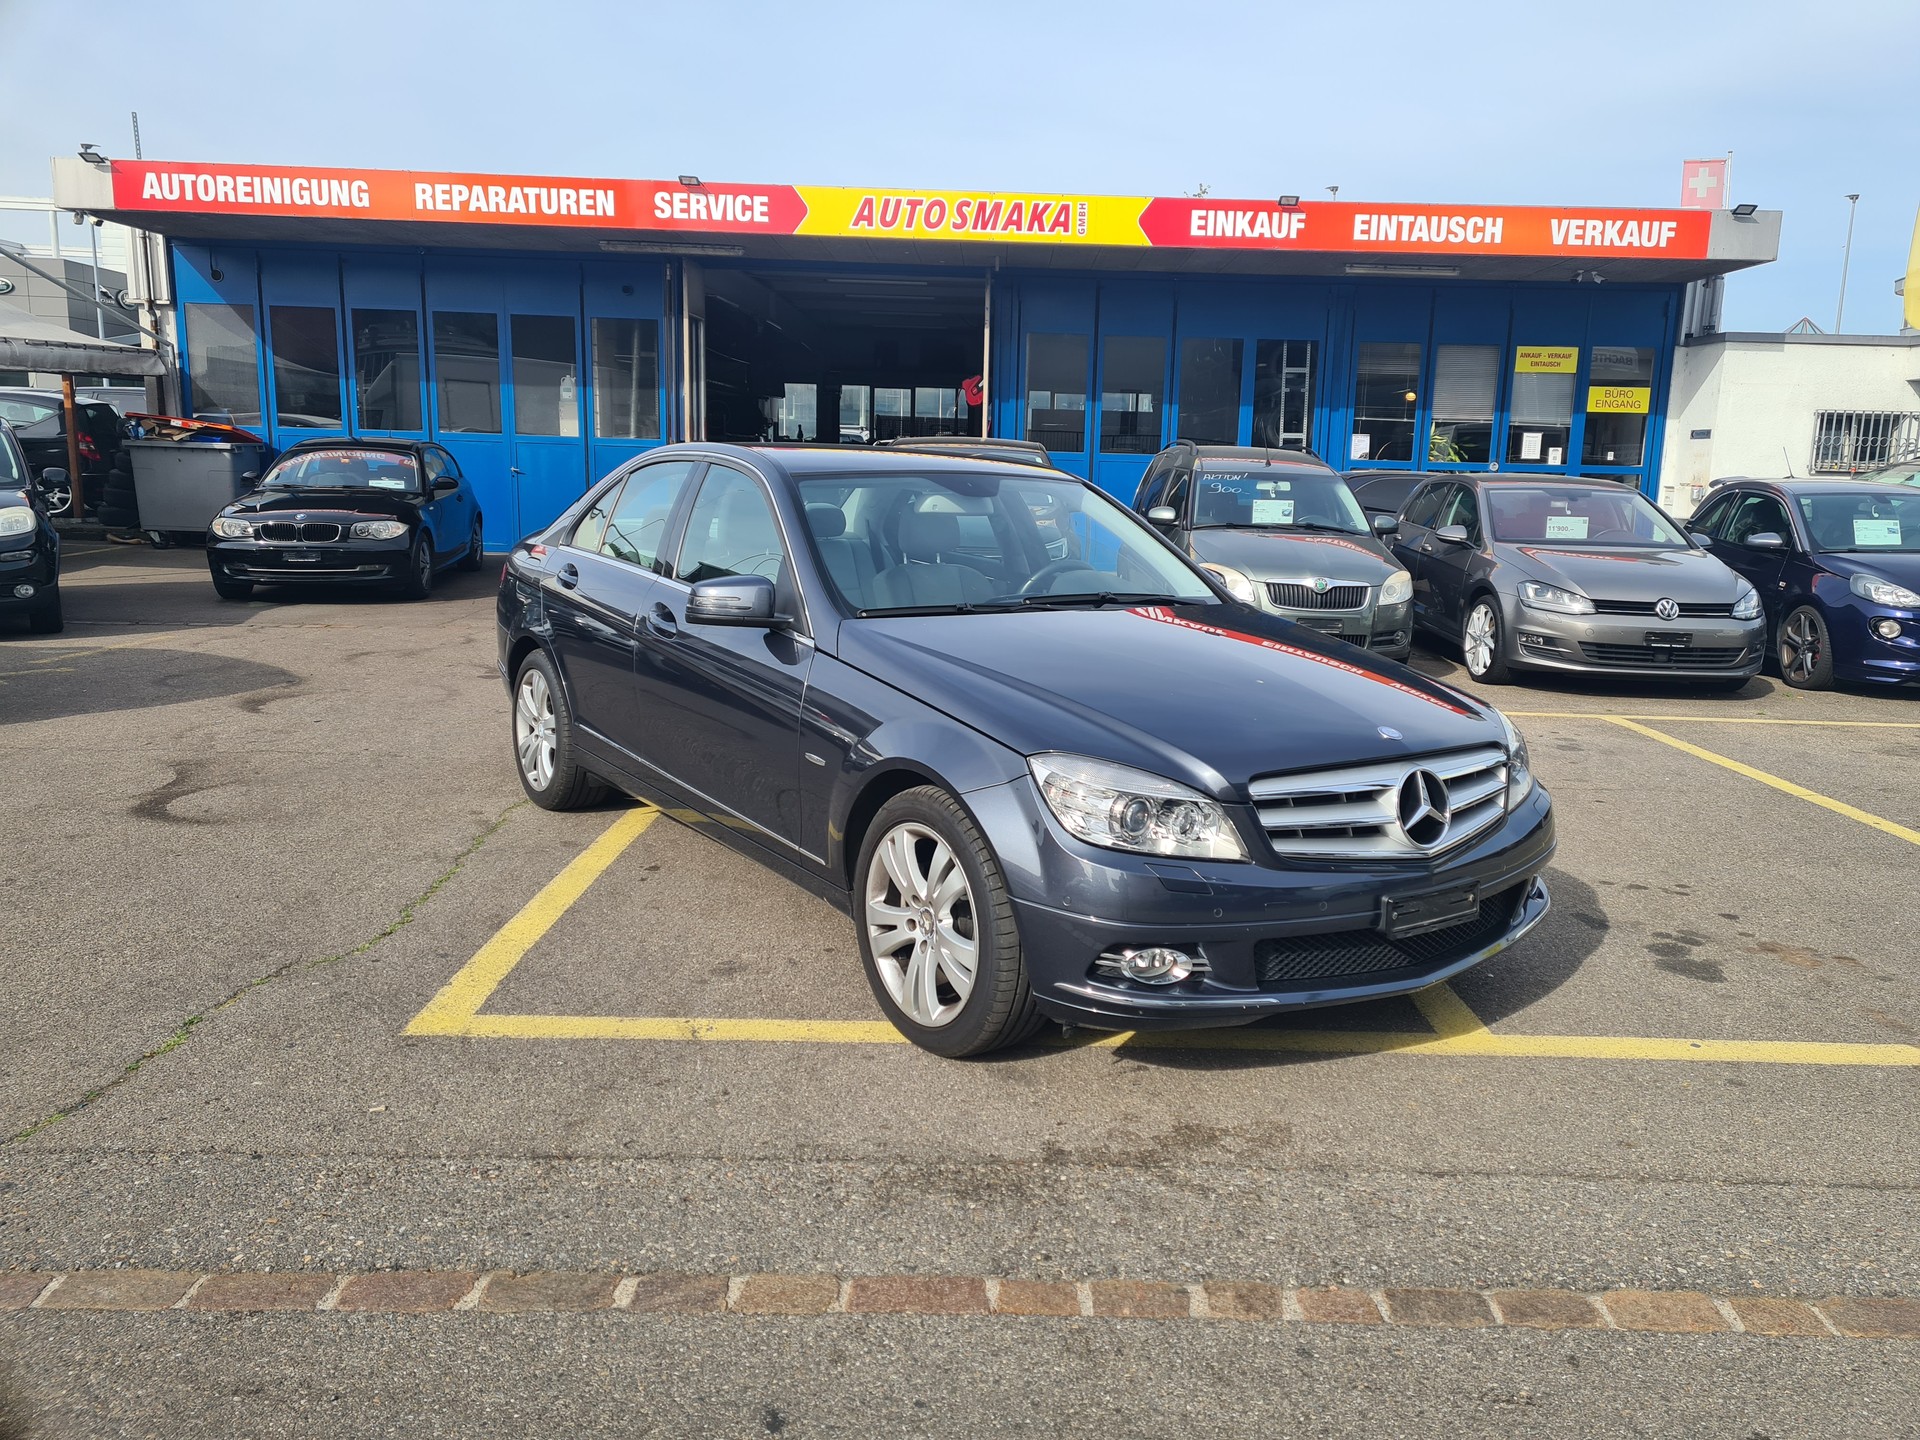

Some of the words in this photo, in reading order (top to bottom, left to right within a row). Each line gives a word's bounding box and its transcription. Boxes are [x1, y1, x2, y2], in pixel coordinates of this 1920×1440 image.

[142, 171, 370, 209] AUTOREINIGUNG
[414, 182, 616, 217] REPARATUREN
[653, 190, 770, 223] SERVICE
[851, 196, 948, 230] AUTO
[951, 199, 1072, 235] SMAKA
[1076, 202, 1088, 235] GMBH
[1190, 209, 1307, 240] EINKAUF
[1352, 213, 1504, 245] EINTAUSCH
[1550, 218, 1678, 248] VERKAUF
[1595, 400, 1642, 409] EINGANG
[1604, 388, 1634, 399] BÜRO
